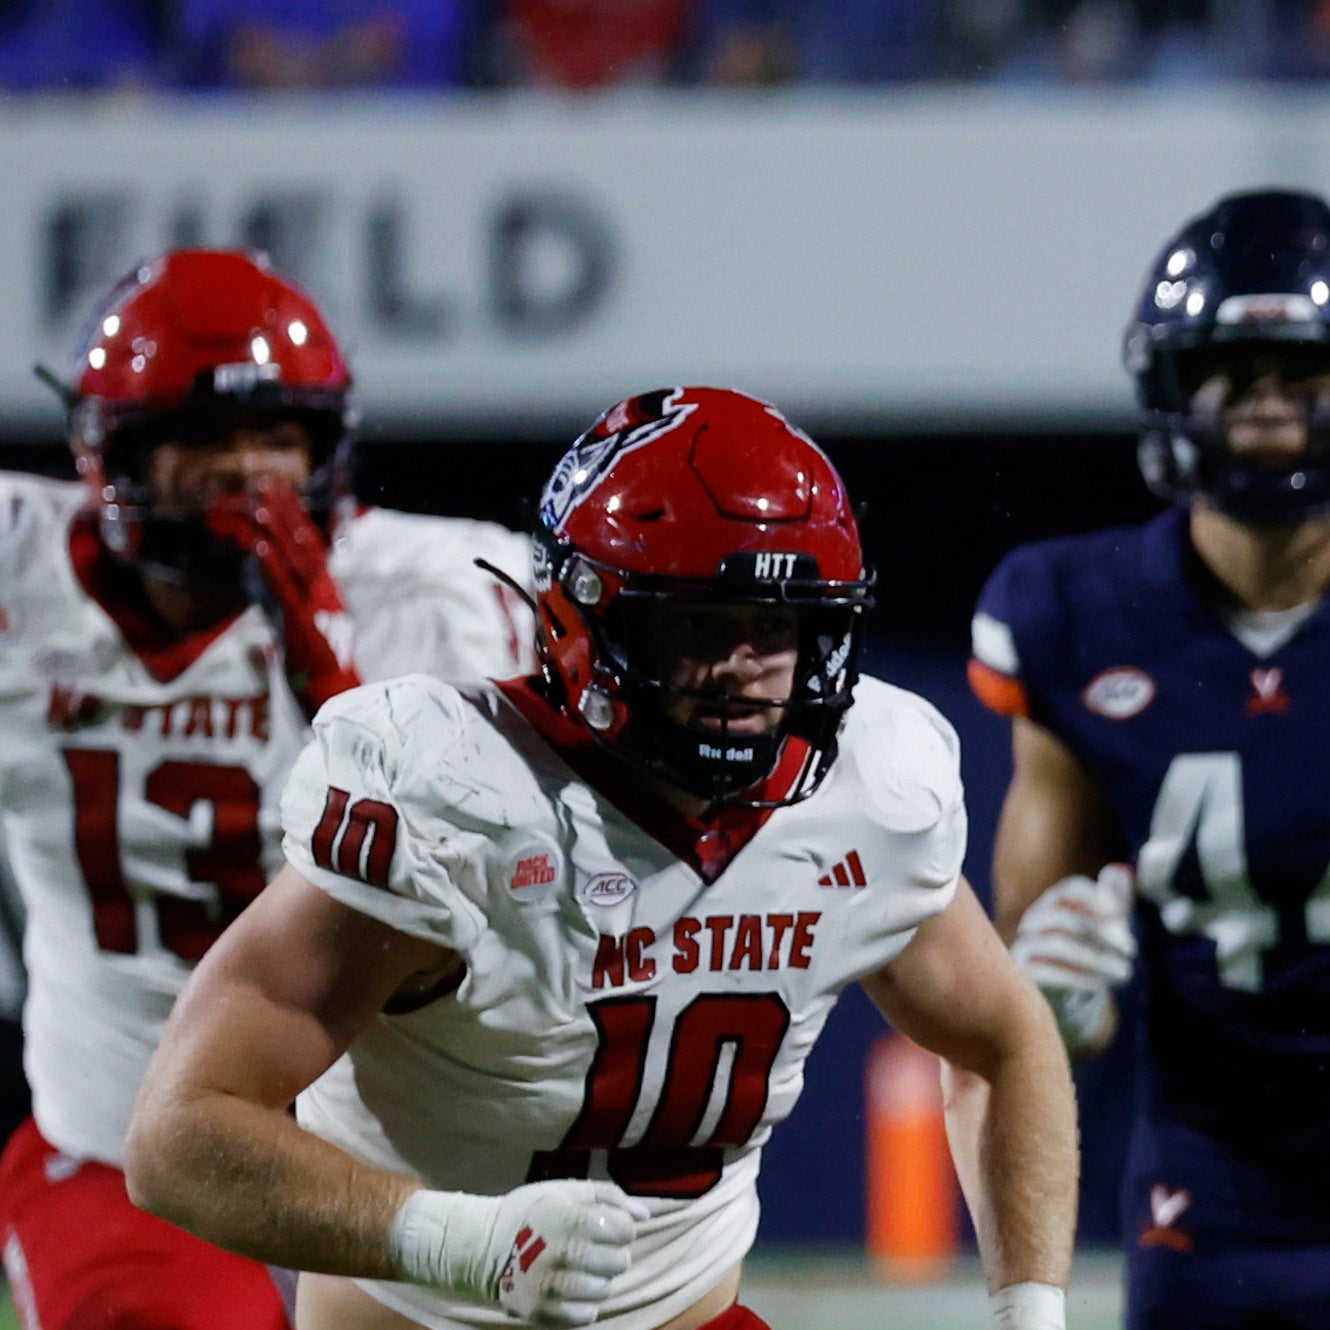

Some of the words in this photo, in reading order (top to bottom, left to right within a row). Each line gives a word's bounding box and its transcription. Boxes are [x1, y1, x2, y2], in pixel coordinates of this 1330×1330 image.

[755, 552, 799, 579] HTT
[60, 747, 268, 962] 13
[311, 785, 399, 891] 10
[591, 879, 627, 896] ACC
[593, 926, 656, 988] NC
[672, 911, 822, 974] STATE
[525, 991, 791, 1200] 10
